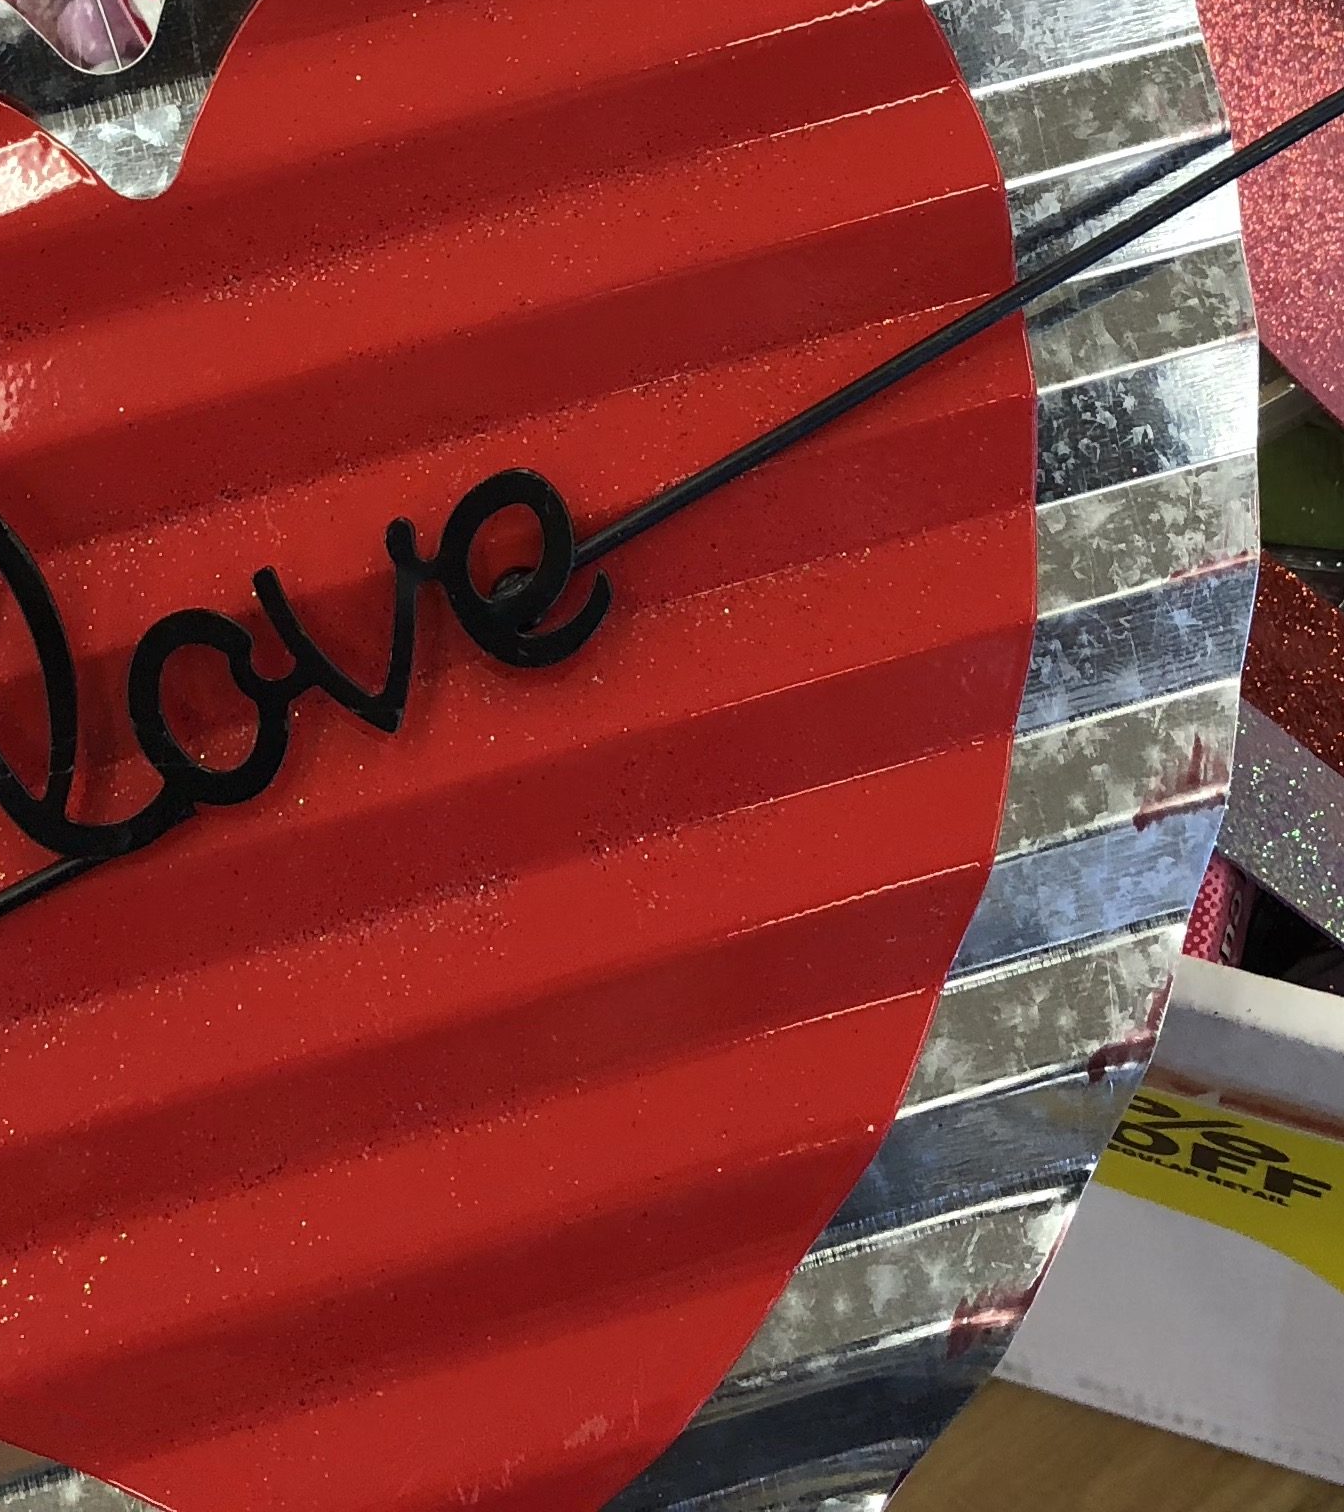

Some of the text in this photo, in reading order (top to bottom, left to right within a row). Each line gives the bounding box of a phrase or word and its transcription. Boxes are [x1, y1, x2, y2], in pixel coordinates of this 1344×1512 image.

[1107, 1141, 1290, 1209] EGULAR RETAIL
[1110, 1120, 1333, 1198] OFF
